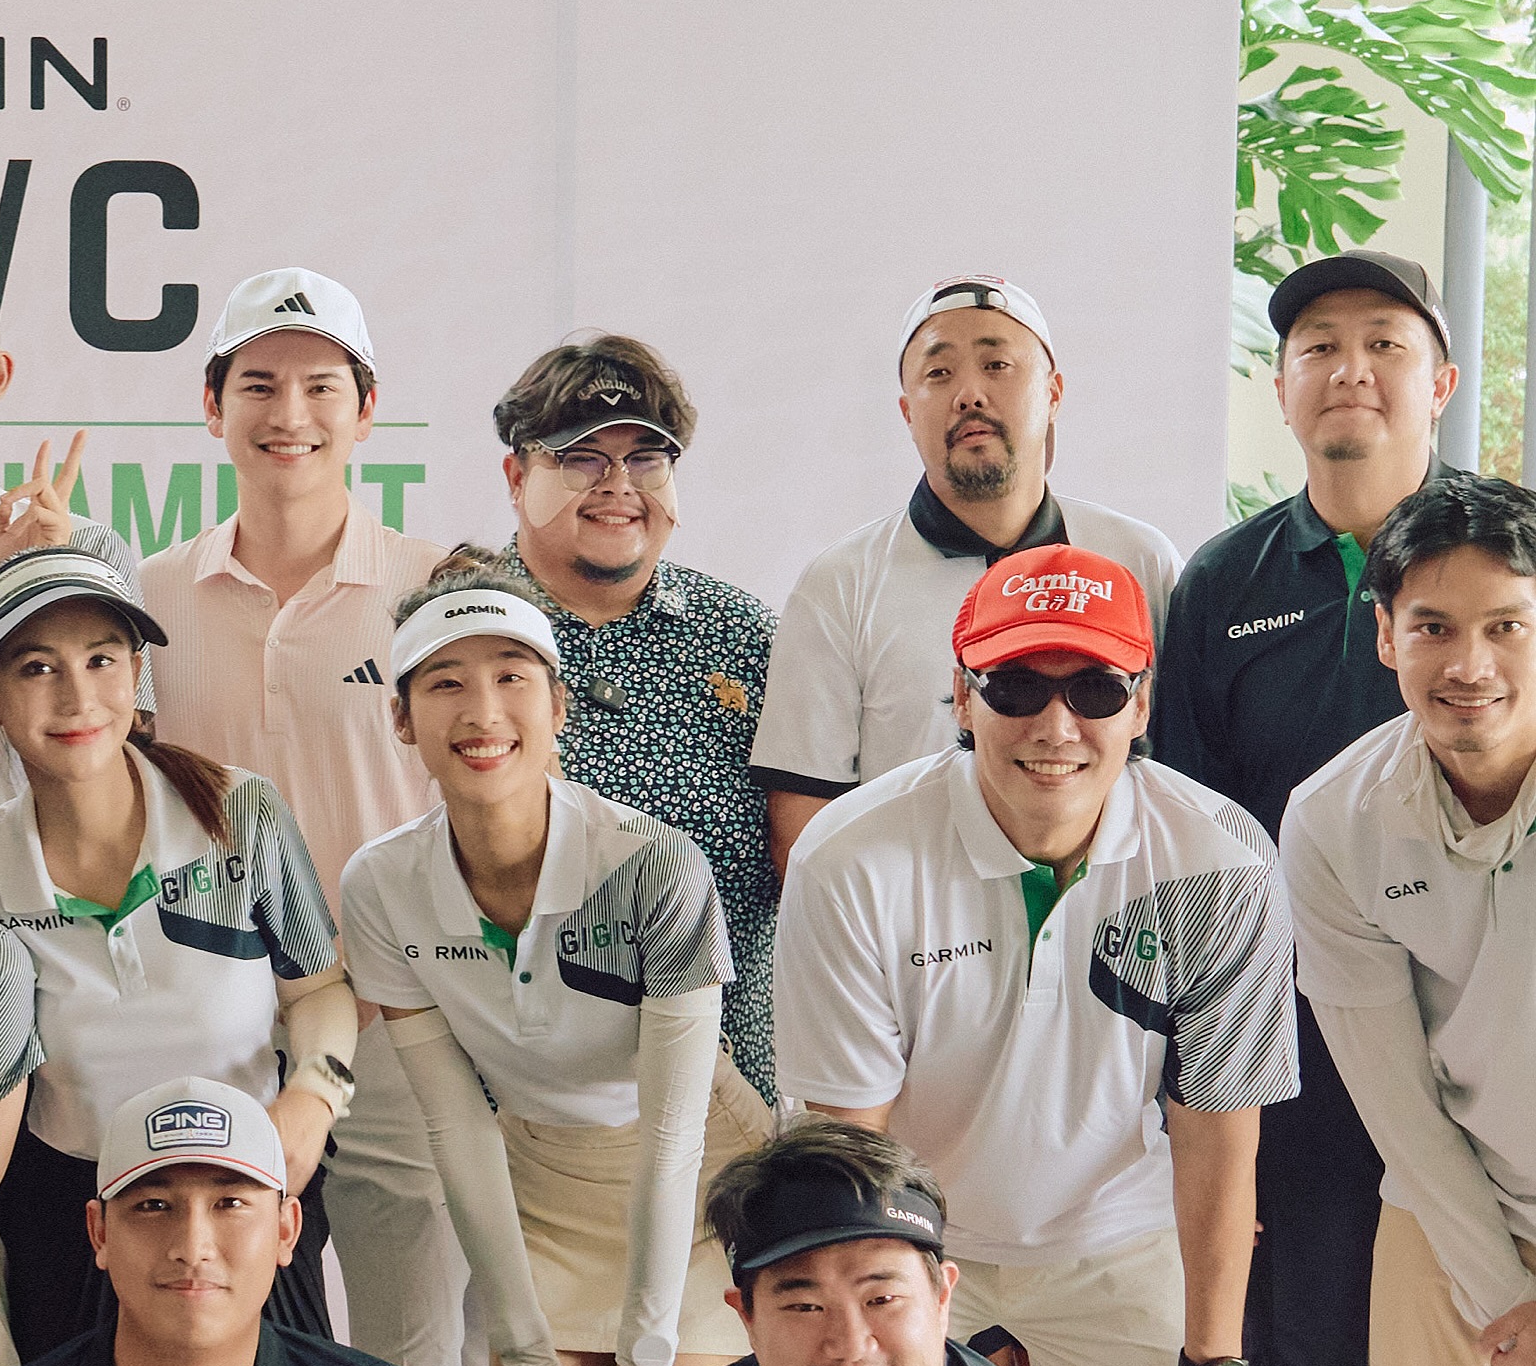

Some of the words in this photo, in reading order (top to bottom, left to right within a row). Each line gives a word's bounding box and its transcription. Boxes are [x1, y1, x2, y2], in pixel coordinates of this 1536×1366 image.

[1001, 570, 1113, 601] Carnival
[444, 605, 507, 619] GARMIN
[1227, 609, 1305, 639] GARMIN
[161, 854, 246, 906] G/G/C
[1385, 880, 1429, 899] GAR
[404, 944, 489, 961] GRMIN
[911, 938, 993, 967] GARMIN
[155, 1111, 224, 1132] PING
[886, 1207, 935, 1235] GARMIN
